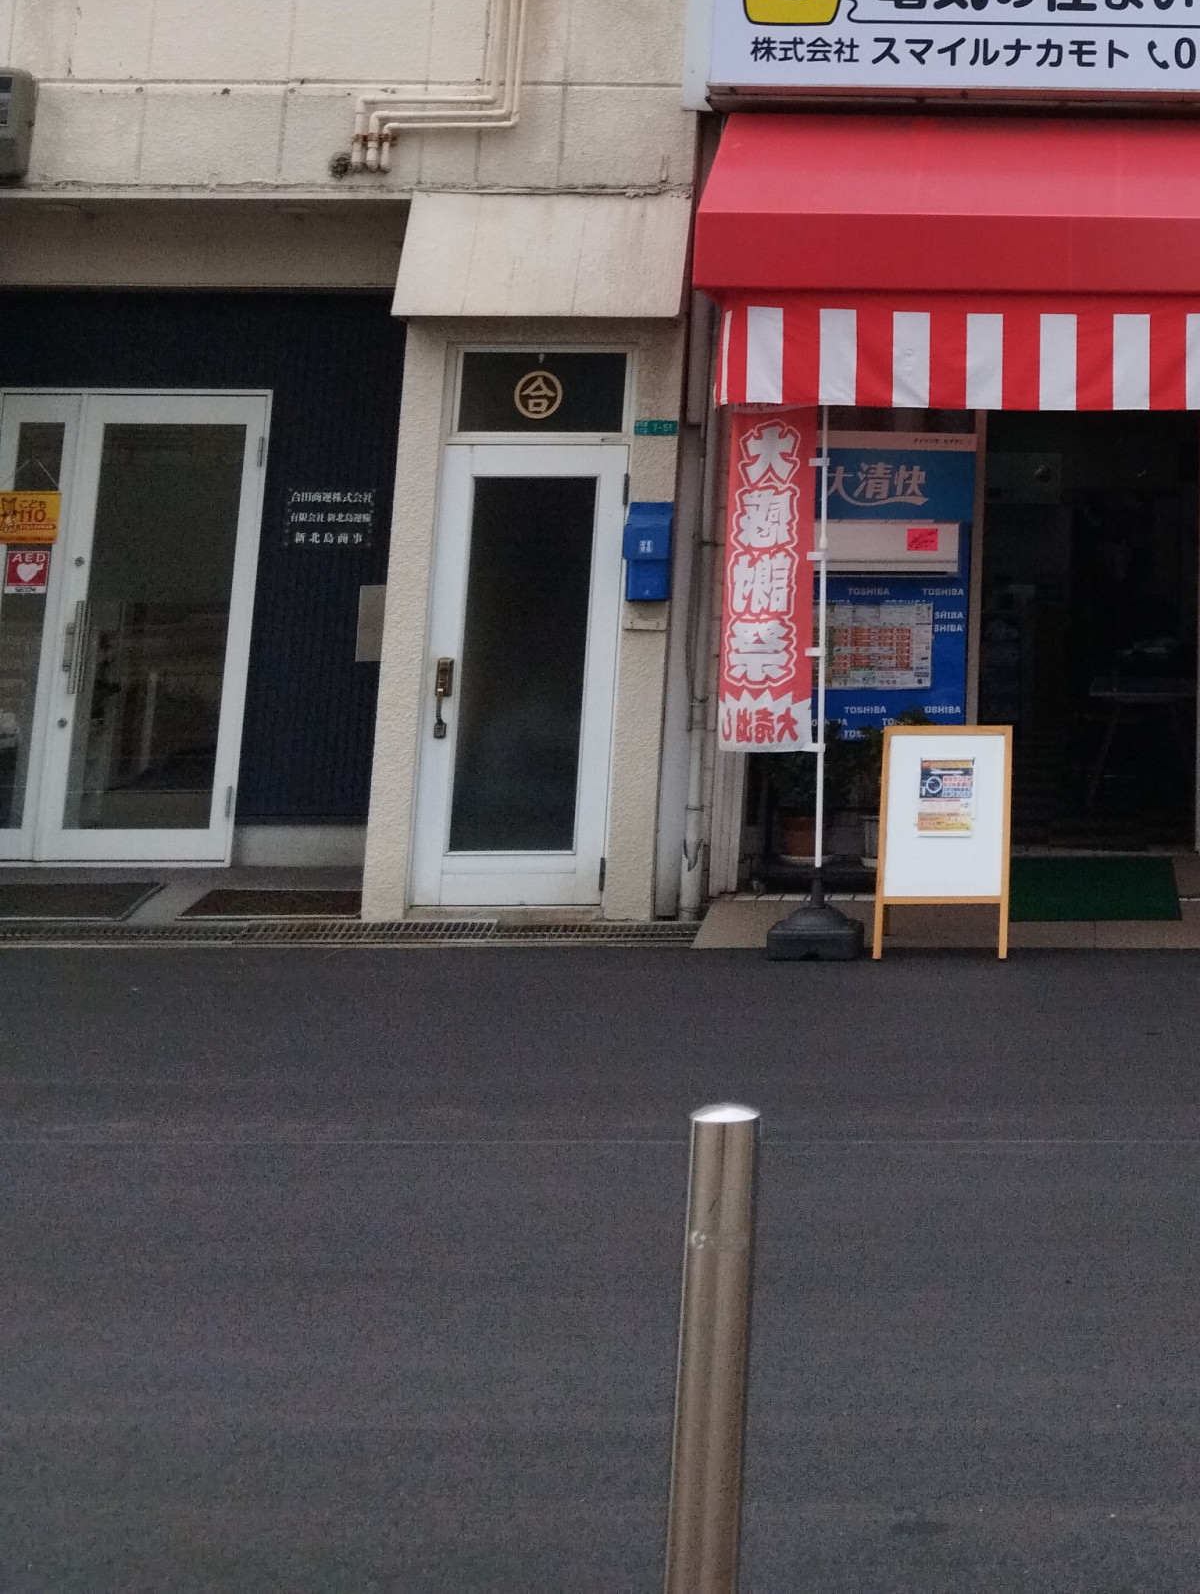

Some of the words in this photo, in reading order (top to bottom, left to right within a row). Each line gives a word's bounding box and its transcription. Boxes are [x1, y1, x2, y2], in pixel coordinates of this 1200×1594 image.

[750, 36, 860, 64] 株式会社
[870, 37, 1130, 70] スマイルナカモト
[826, 461, 930, 506] 大清快
[12, 553, 46, 563] AED
[849, 587, 890, 596] TOSHIBA
[922, 587, 964, 596] TOSHIBA
[934, 611, 964, 619] SHIBA
[934, 624, 964, 632] SHIBA
[844, 706, 887, 714] TOSHIBA
[924, 706, 961, 714] OSHIBA
